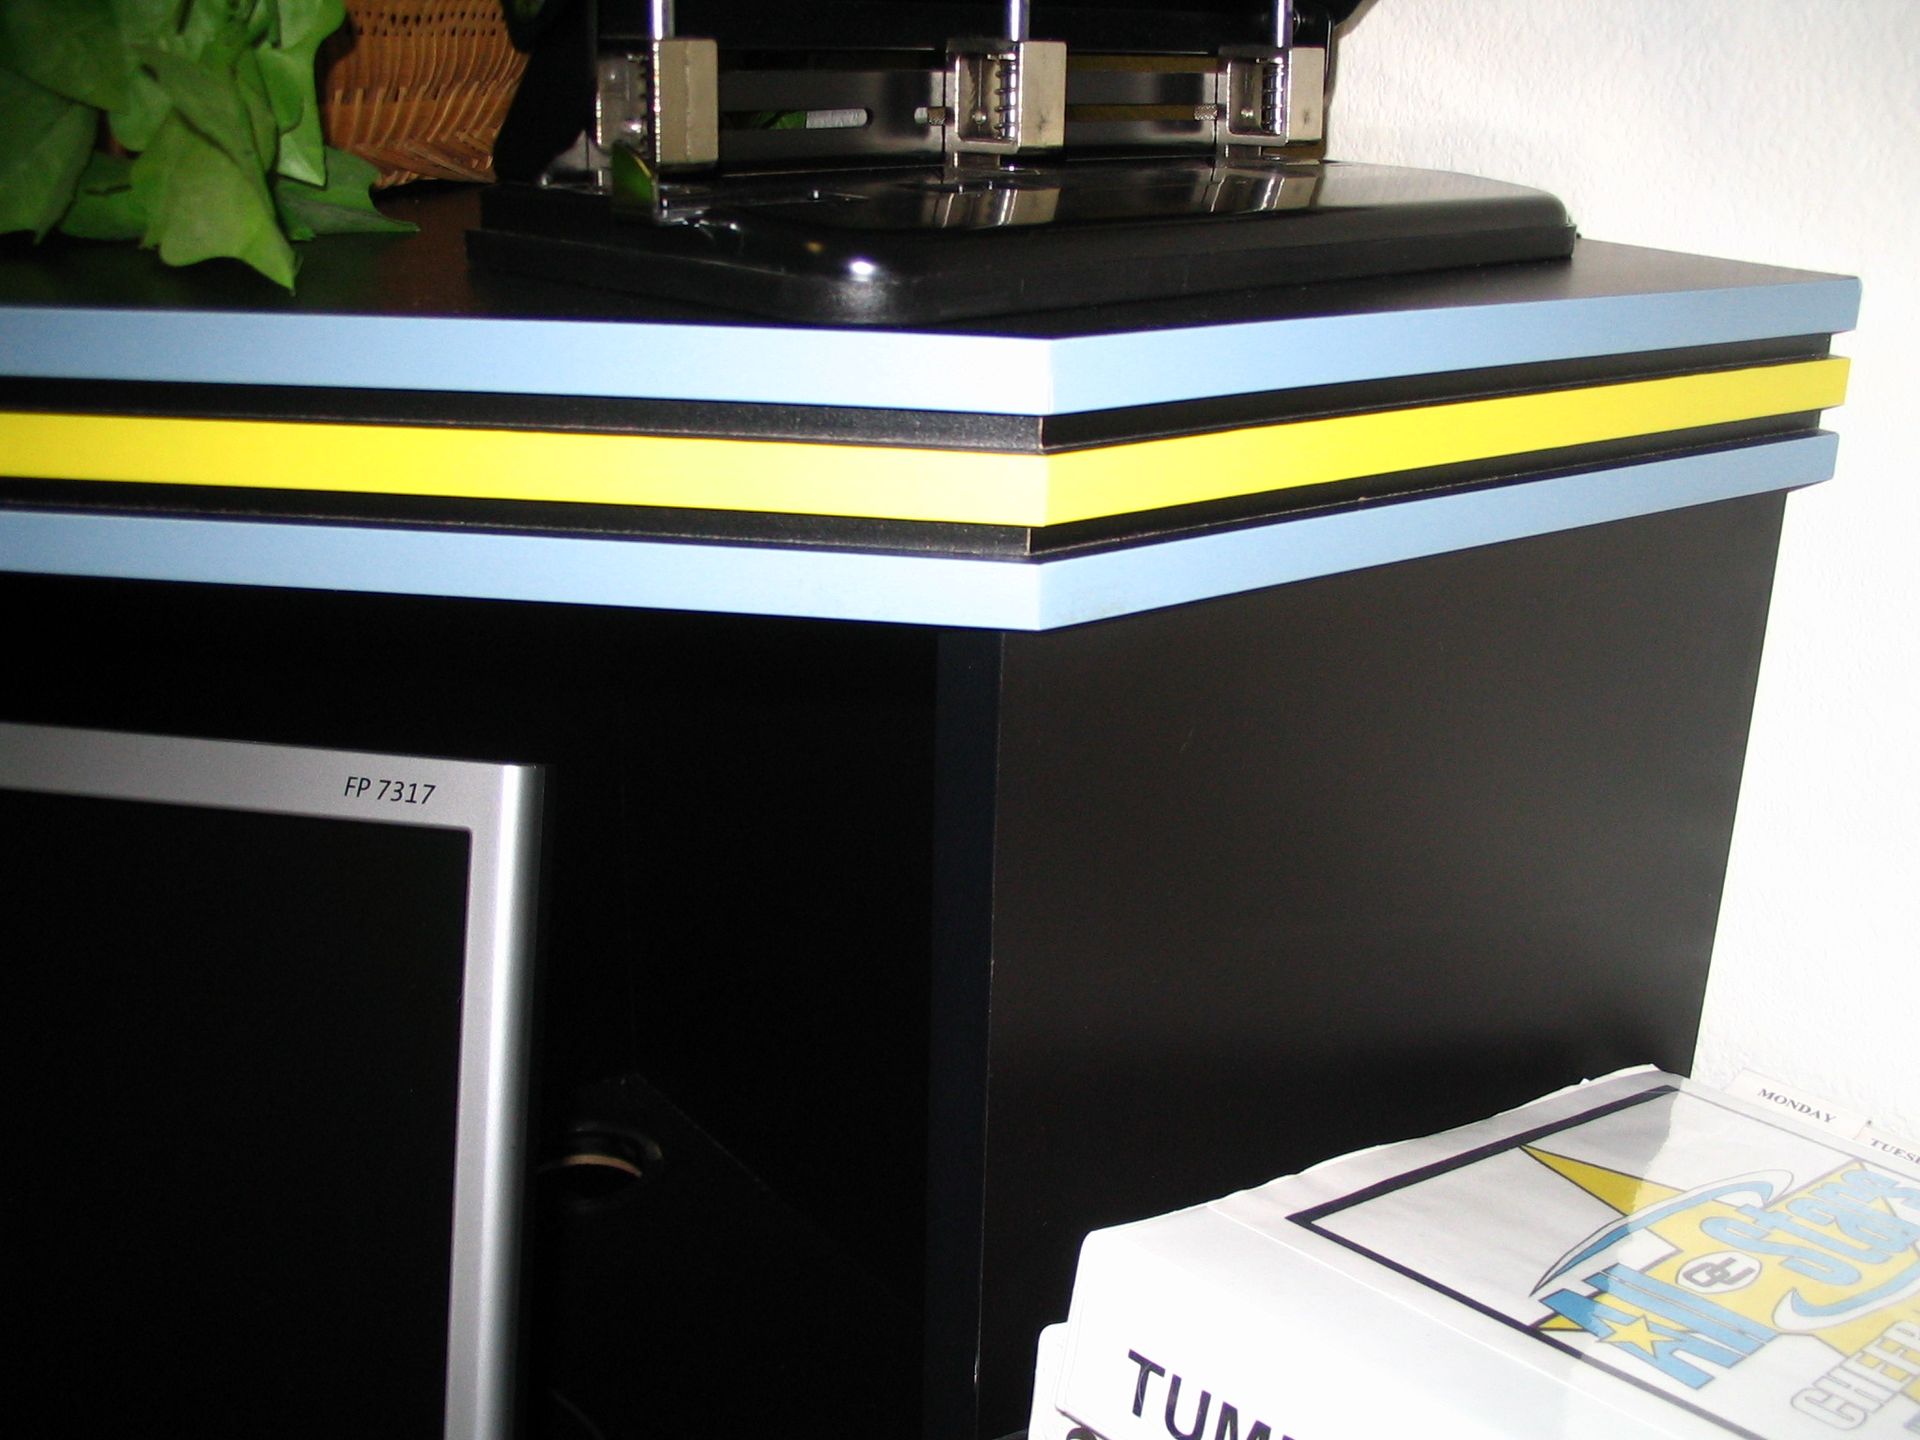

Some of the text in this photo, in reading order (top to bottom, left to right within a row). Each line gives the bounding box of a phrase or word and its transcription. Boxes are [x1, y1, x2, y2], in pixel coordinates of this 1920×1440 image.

[344, 776, 437, 805] FP 7317
[1757, 1088, 1837, 1123] MONDAY
